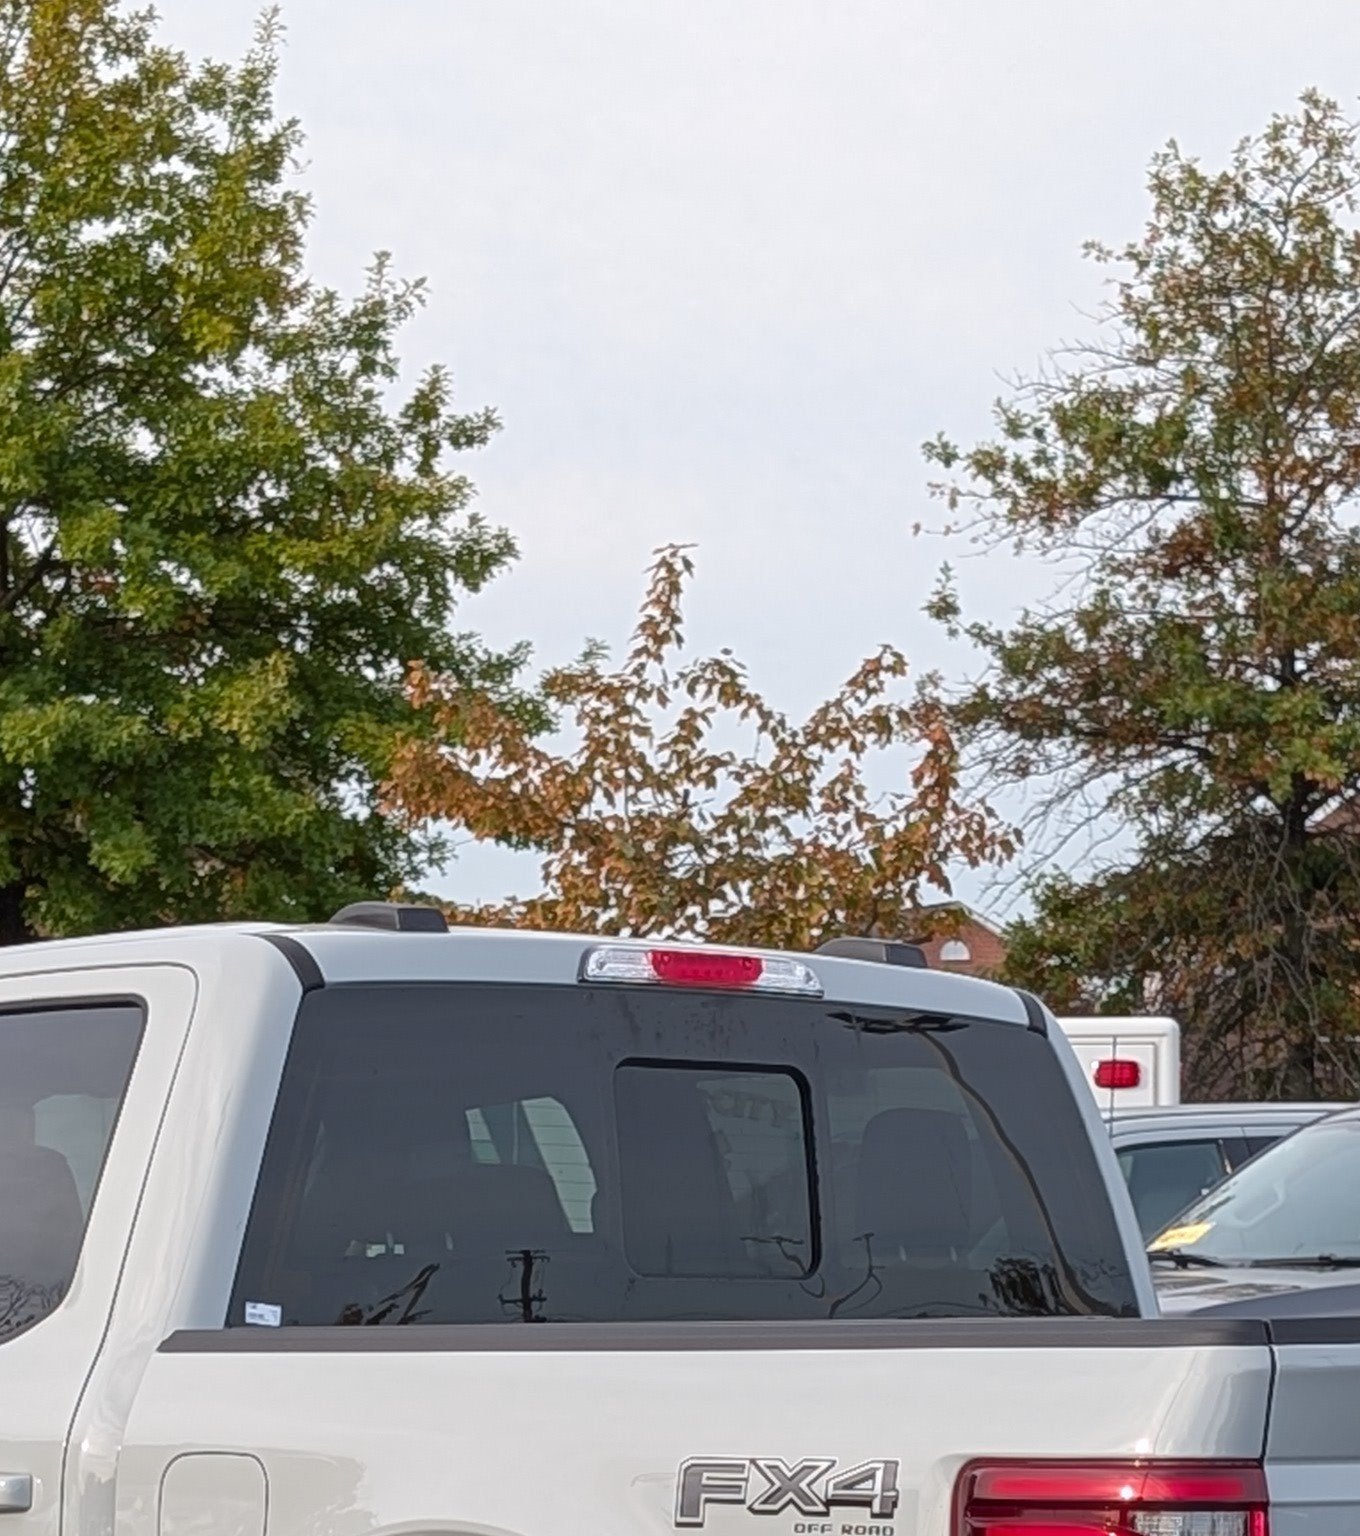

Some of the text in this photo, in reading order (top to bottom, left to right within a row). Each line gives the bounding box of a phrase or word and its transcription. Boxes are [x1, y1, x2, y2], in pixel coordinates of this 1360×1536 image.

[674, 1456, 900, 1529] FX4
[793, 1522, 895, 1536] OFF ROAD
